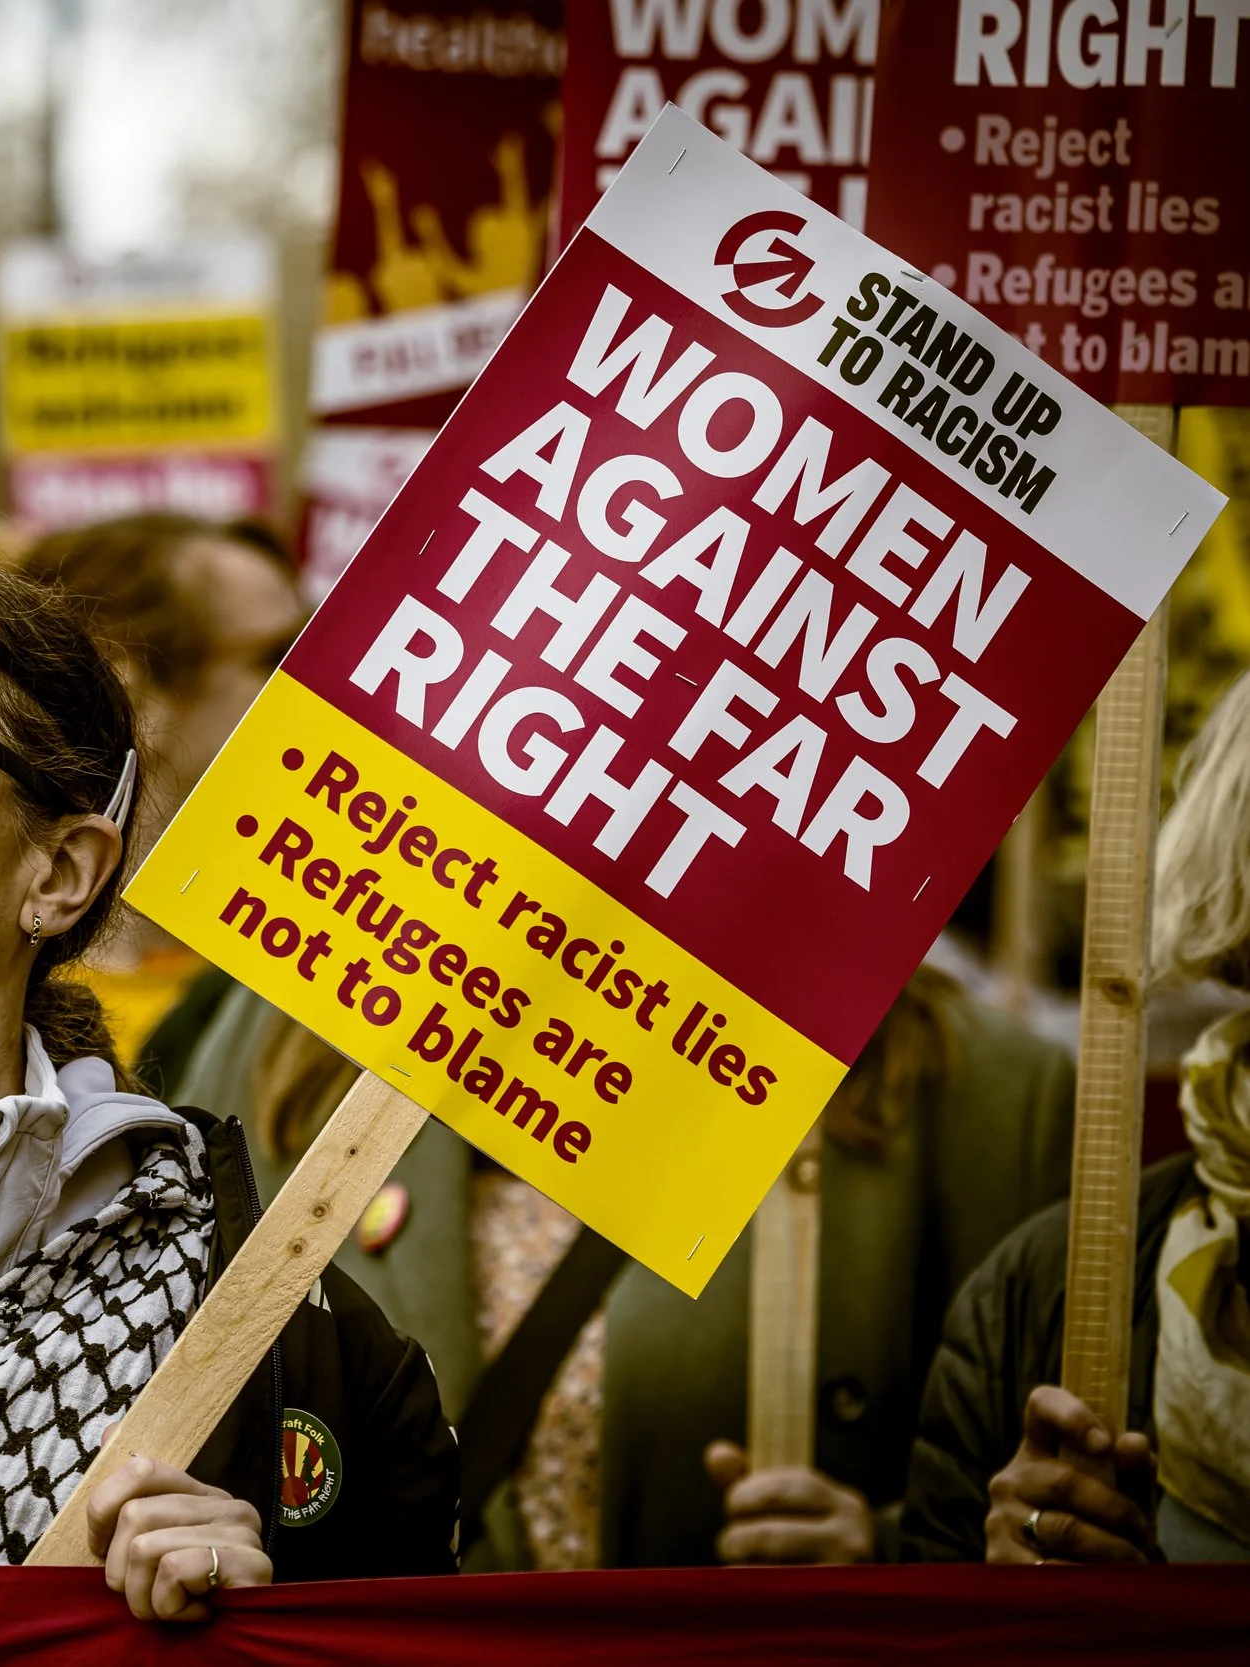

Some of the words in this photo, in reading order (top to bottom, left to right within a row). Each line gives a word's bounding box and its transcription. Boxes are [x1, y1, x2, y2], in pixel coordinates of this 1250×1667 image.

[594, 66, 875, 167] AGAI
[954, 0, 1250, 89] RIGHT
[968, 181, 1114, 233] racist
[1126, 181, 1221, 235] lies
[975, 114, 1132, 180] Reject
[846, 272, 995, 398] STAND
[991, 378, 1062, 442] UP
[966, 251, 1198, 319] Refugees
[1213, 270, 1250, 310] a
[1060, 322, 1108, 373] to
[565, 282, 1032, 664] WOMEN
[816, 315, 884, 387] TO
[876, 360, 1058, 516] RACISM
[478, 400, 1019, 791] AGAINST
[348, 593, 748, 900] RIGHT
[435, 488, 689, 719] THE
[668, 658, 911, 892] FAR
[258, 817, 532, 1030] Refugees
[533, 1017, 633, 1104] are
[304, 751, 499, 909] Reject
[498, 891, 671, 1032] racist
[672, 1001, 778, 1106] lies
[219, 887, 333, 982] not
[337, 958, 402, 1026] to
[407, 1002, 592, 1164] blame
[281, 1419, 303, 1430] raft
[304, 1423, 325, 1446] Folk
[282, 1506, 302, 1520] THE
[301, 1501, 322, 1518] FAR
